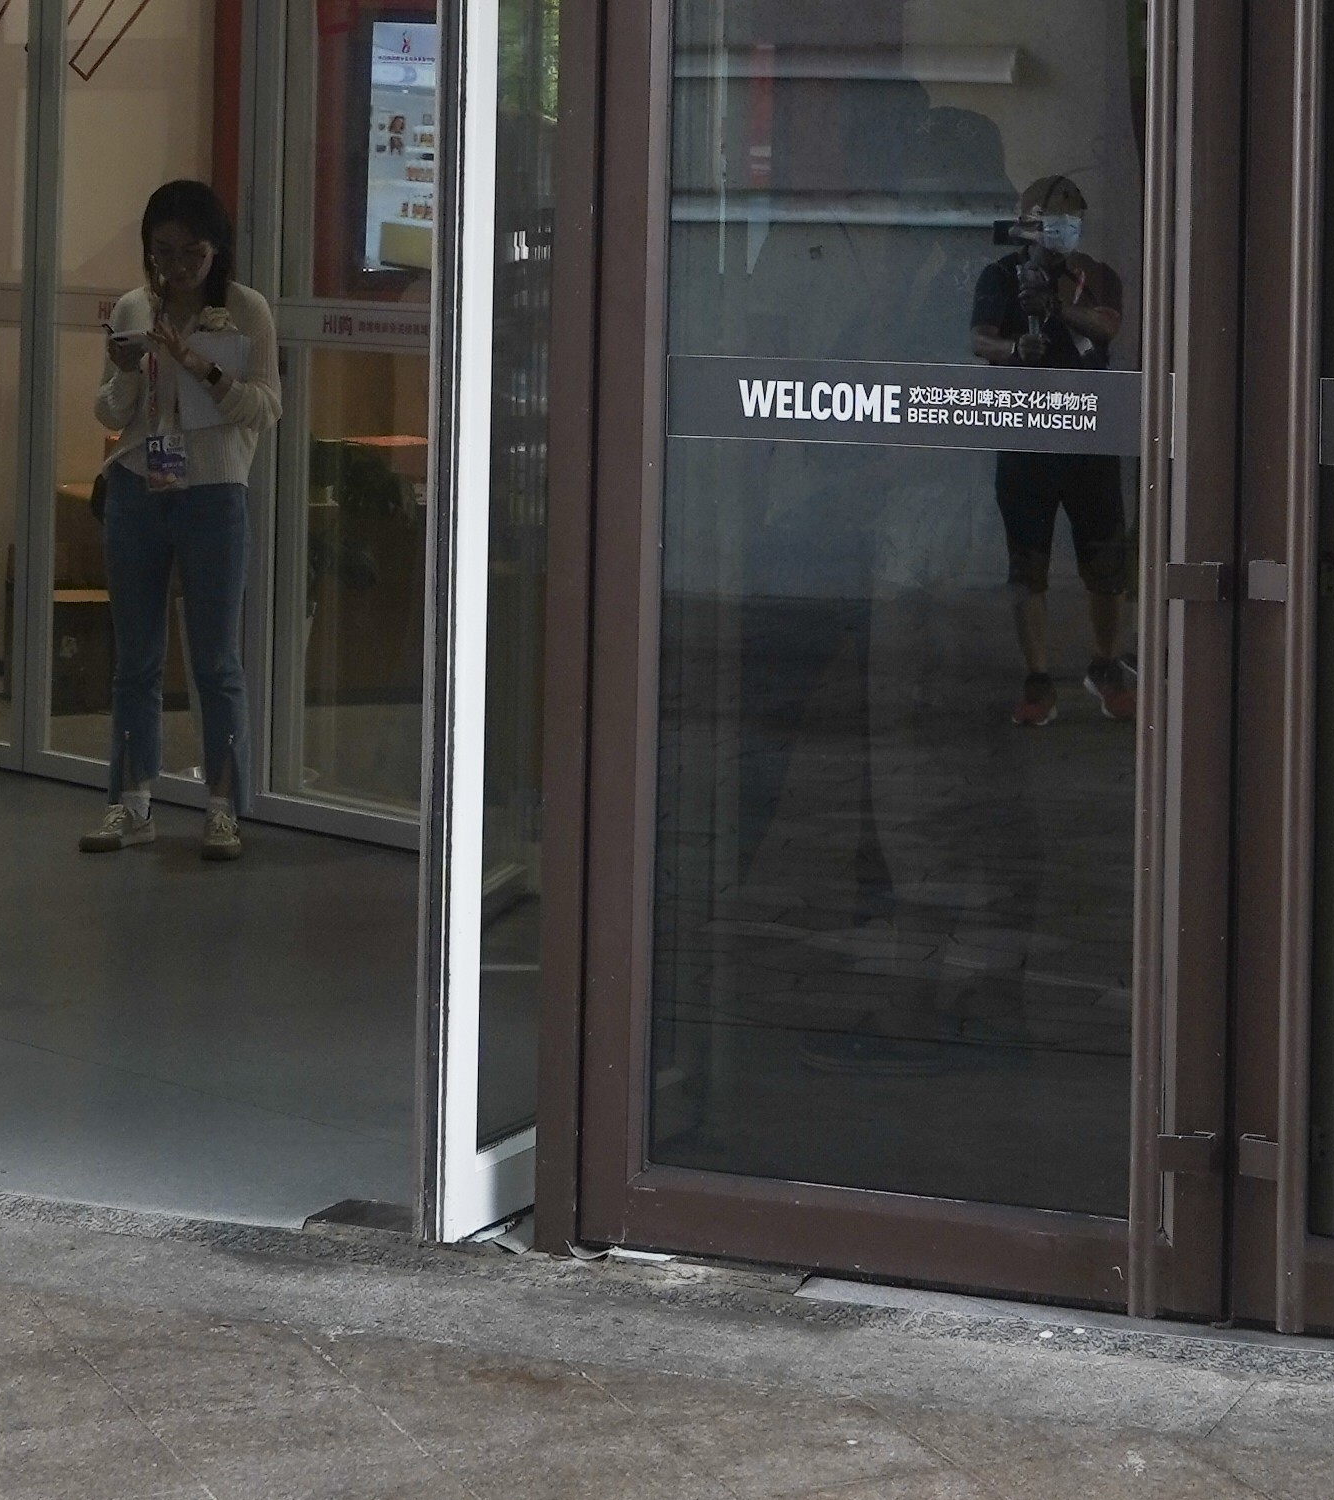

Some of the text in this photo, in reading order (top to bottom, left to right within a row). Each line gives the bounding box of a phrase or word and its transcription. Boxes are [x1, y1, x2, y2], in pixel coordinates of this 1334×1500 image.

[738, 378, 902, 424] WELCOME
[908, 385, 1099, 412] 欢迎来到啤酒文化博物馆
[908, 408, 1097, 431] BEER CULTURE MUSEUM
